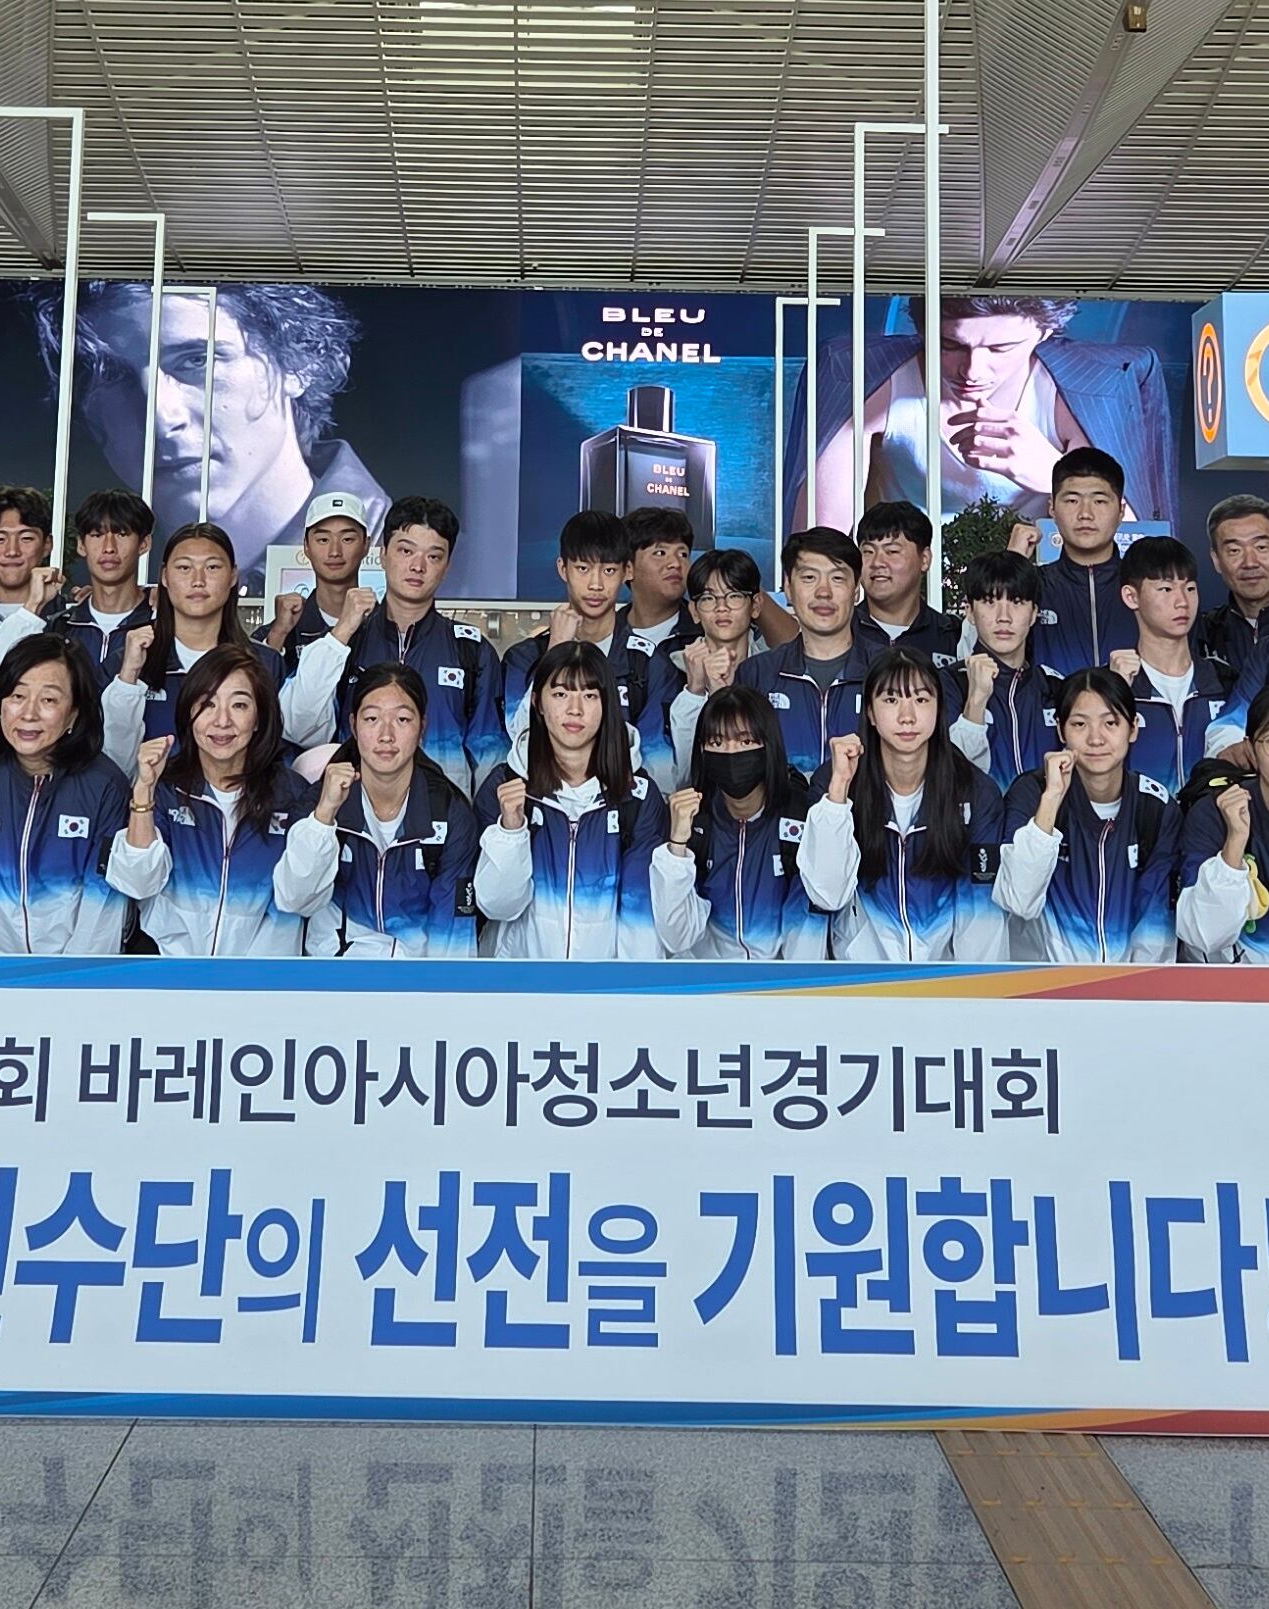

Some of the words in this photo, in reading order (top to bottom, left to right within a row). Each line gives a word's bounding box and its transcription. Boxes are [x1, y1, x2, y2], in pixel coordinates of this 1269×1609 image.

[602, 307, 706, 324] BLEU
[641, 327, 664, 337] DE
[581, 341, 722, 363] CHANEL
[653, 463, 686, 476] BLEU
[646, 483, 690, 497] CHANEL
[80, 1038, 1059, 1134] 바레인아시아청소년경기대회
[355, 1171, 667, 1349] 선전을
